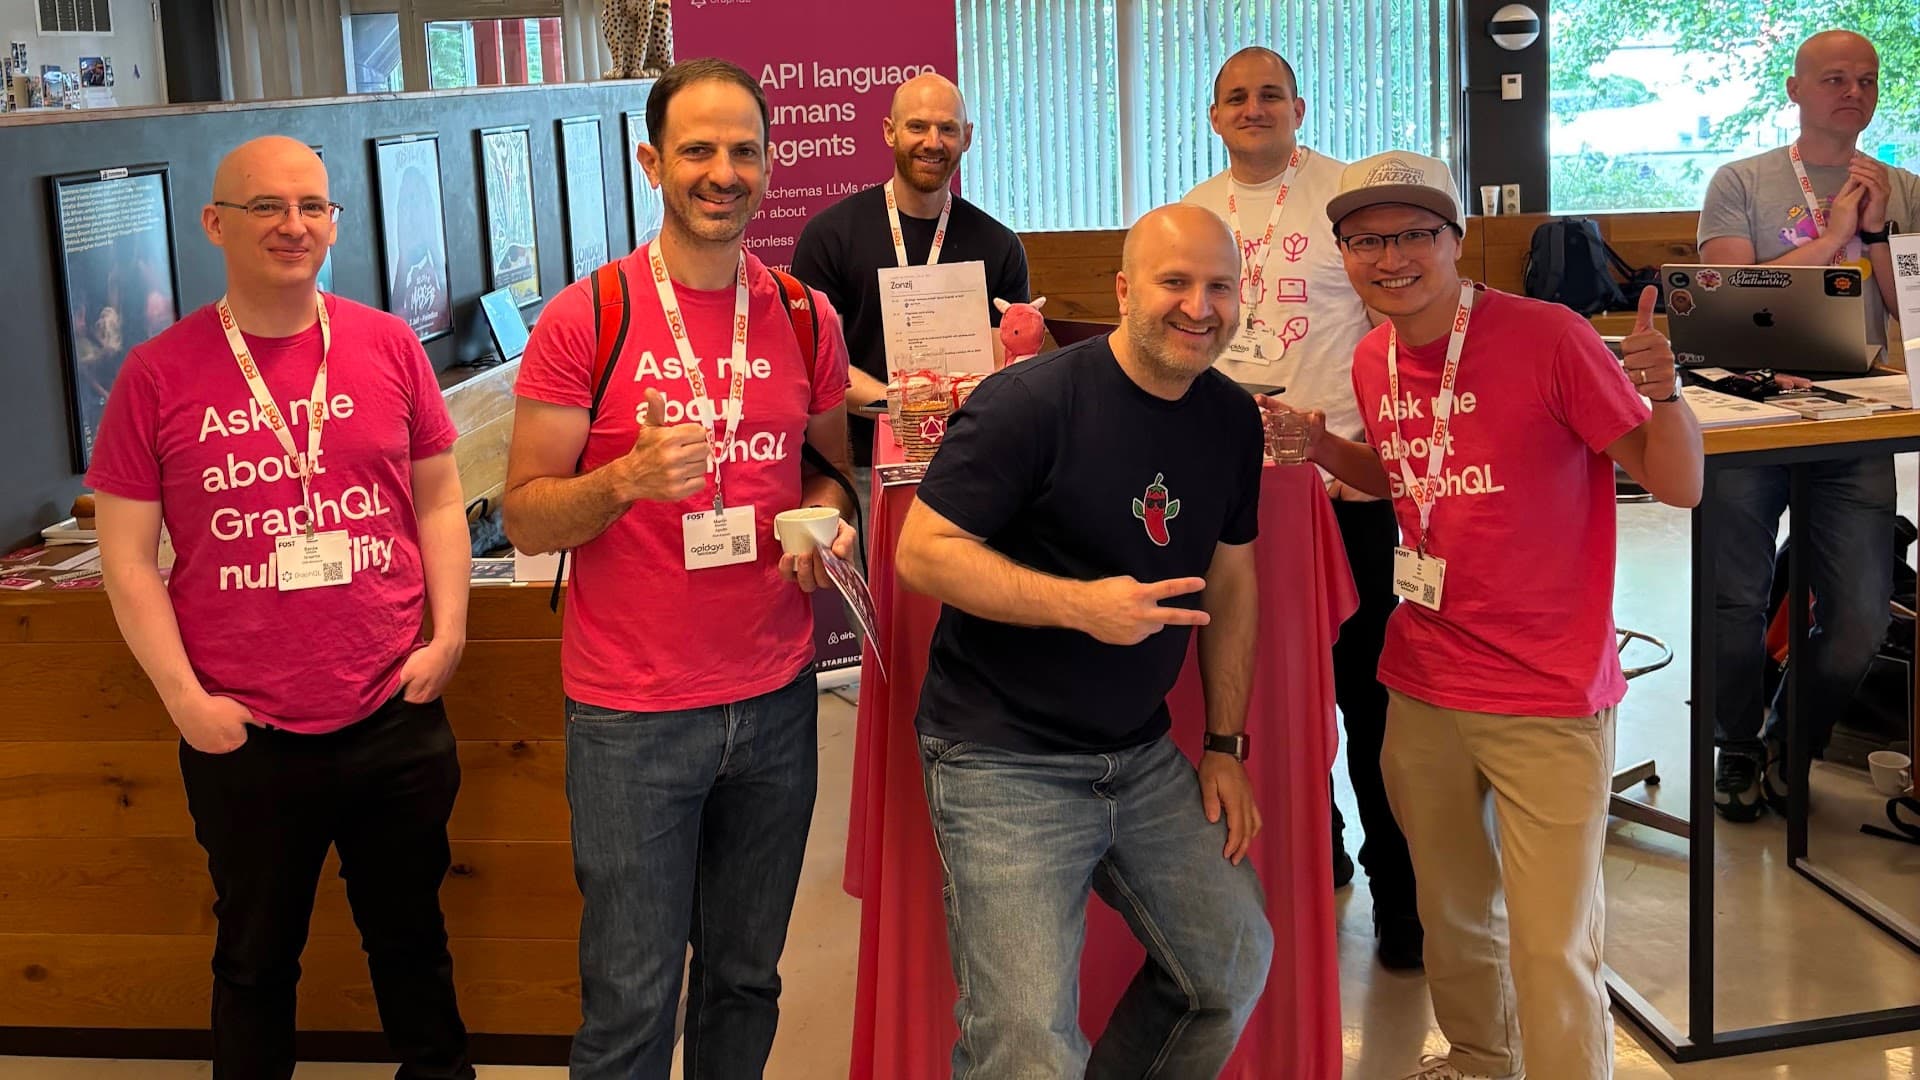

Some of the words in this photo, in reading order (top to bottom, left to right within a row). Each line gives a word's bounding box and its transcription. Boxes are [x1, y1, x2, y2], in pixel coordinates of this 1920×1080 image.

[760, 63, 804, 90] API
[770, 103, 856, 126] umans
[1289, 149, 1299, 168] FOS
[766, 186, 823, 199] schemas
[827, 182, 859, 196] LLMs
[1276, 183, 1289, 206] FOST
[770, 206, 807, 218] about
[742, 234, 794, 248] tionless
[1263, 223, 1275, 246] FOST
[652, 255, 667, 283] FOST
[1252, 263, 1263, 287] FOST
[890, 281, 913, 290] Zonzij
[220, 304, 233, 331] FOST
[667, 308, 685, 340] FOST
[735, 314, 746, 345] FOST
[1455, 304, 1470, 334] FOST
[237, 351, 258, 380] FOST
[633, 351, 705, 382] Ask
[716, 357, 772, 379] me
[1443, 360, 1458, 390] FOST
[687, 366, 705, 398] FOST
[732, 371, 743, 401] FOST
[199, 397, 272, 443] Ask
[289, 394, 354, 426] me
[262, 402, 285, 431] FOST
[312, 401, 324, 433] FOST
[635, 392, 745, 424] abou
[1378, 391, 1425, 422] Ask
[1434, 416, 1447, 447] FOST
[202, 449, 326, 493] about
[1389, 464, 1505, 505] GphQL
[210, 483, 391, 541] GraphQL
[219, 535, 395, 591] nullity
[690, 543, 724, 555] apidays
[840, 631, 855, 641] airb
[821, 654, 863, 668] STARBUCK
